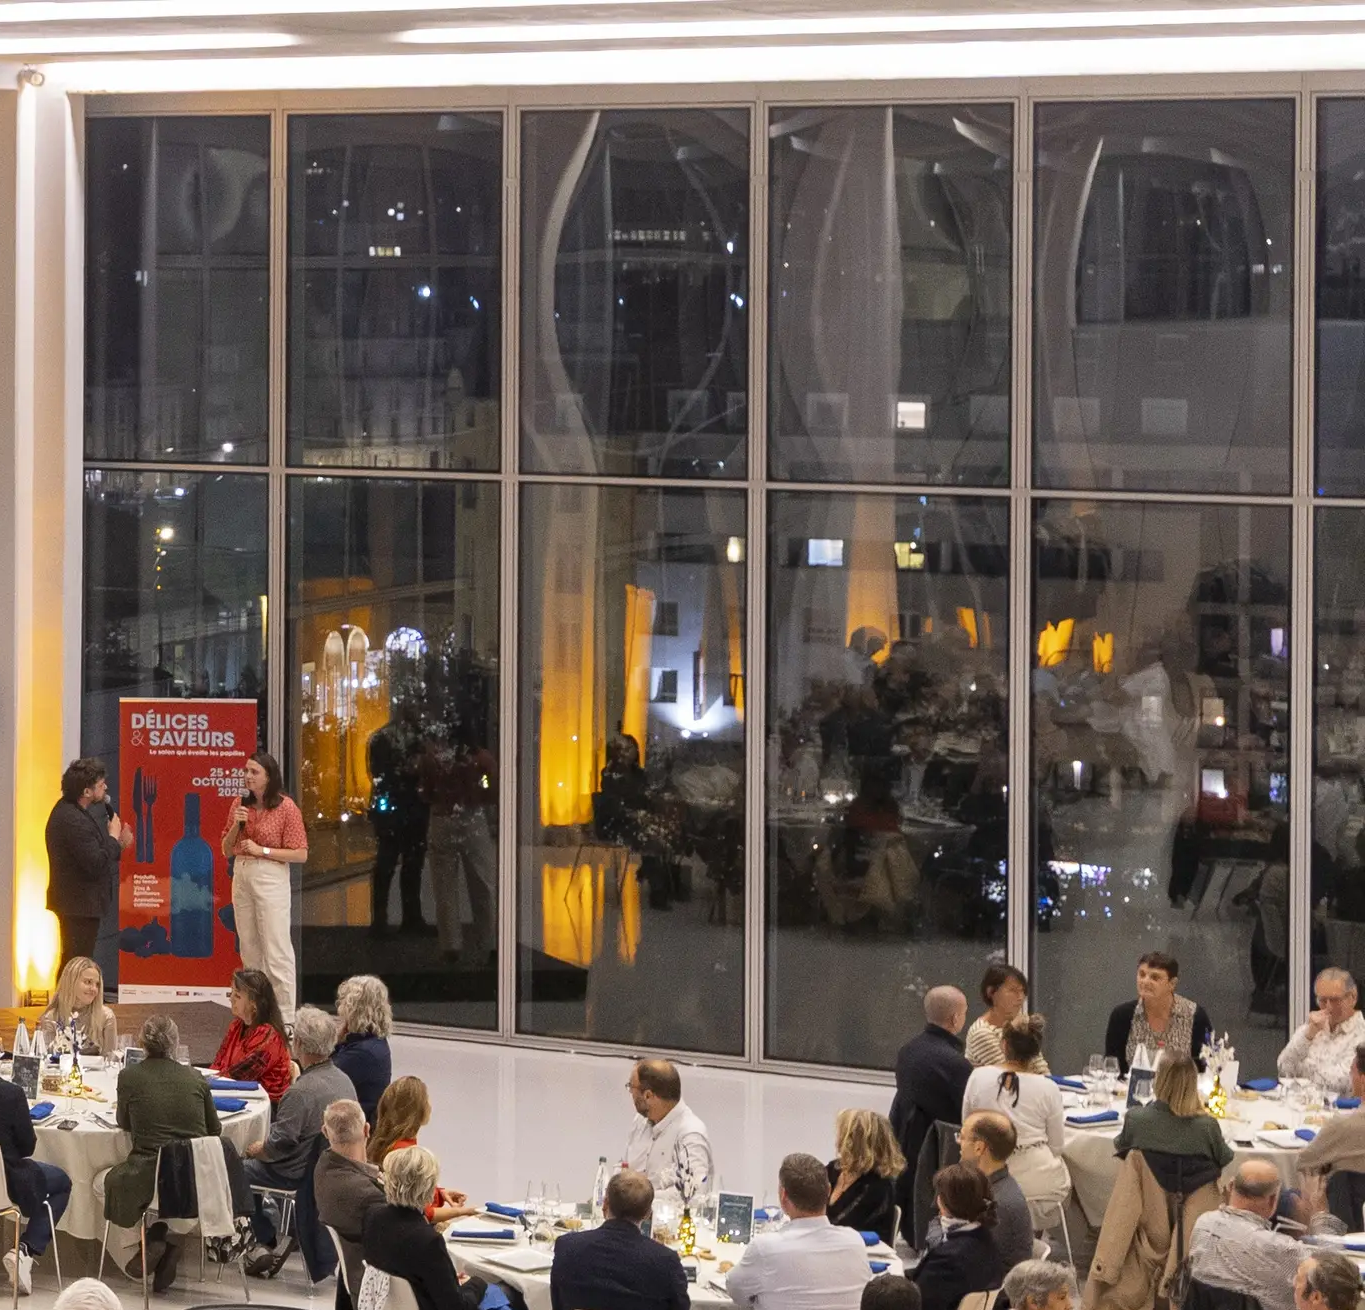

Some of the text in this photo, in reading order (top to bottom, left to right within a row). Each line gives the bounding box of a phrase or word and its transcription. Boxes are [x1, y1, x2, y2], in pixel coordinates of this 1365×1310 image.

[131, 709, 208, 730] DÉLICES
[131, 730, 235, 747] & SAVEURS
[176, 749, 187, 757] qui
[210, 767, 245, 777] 25 26
[192, 777, 245, 787] OCTOBRE
